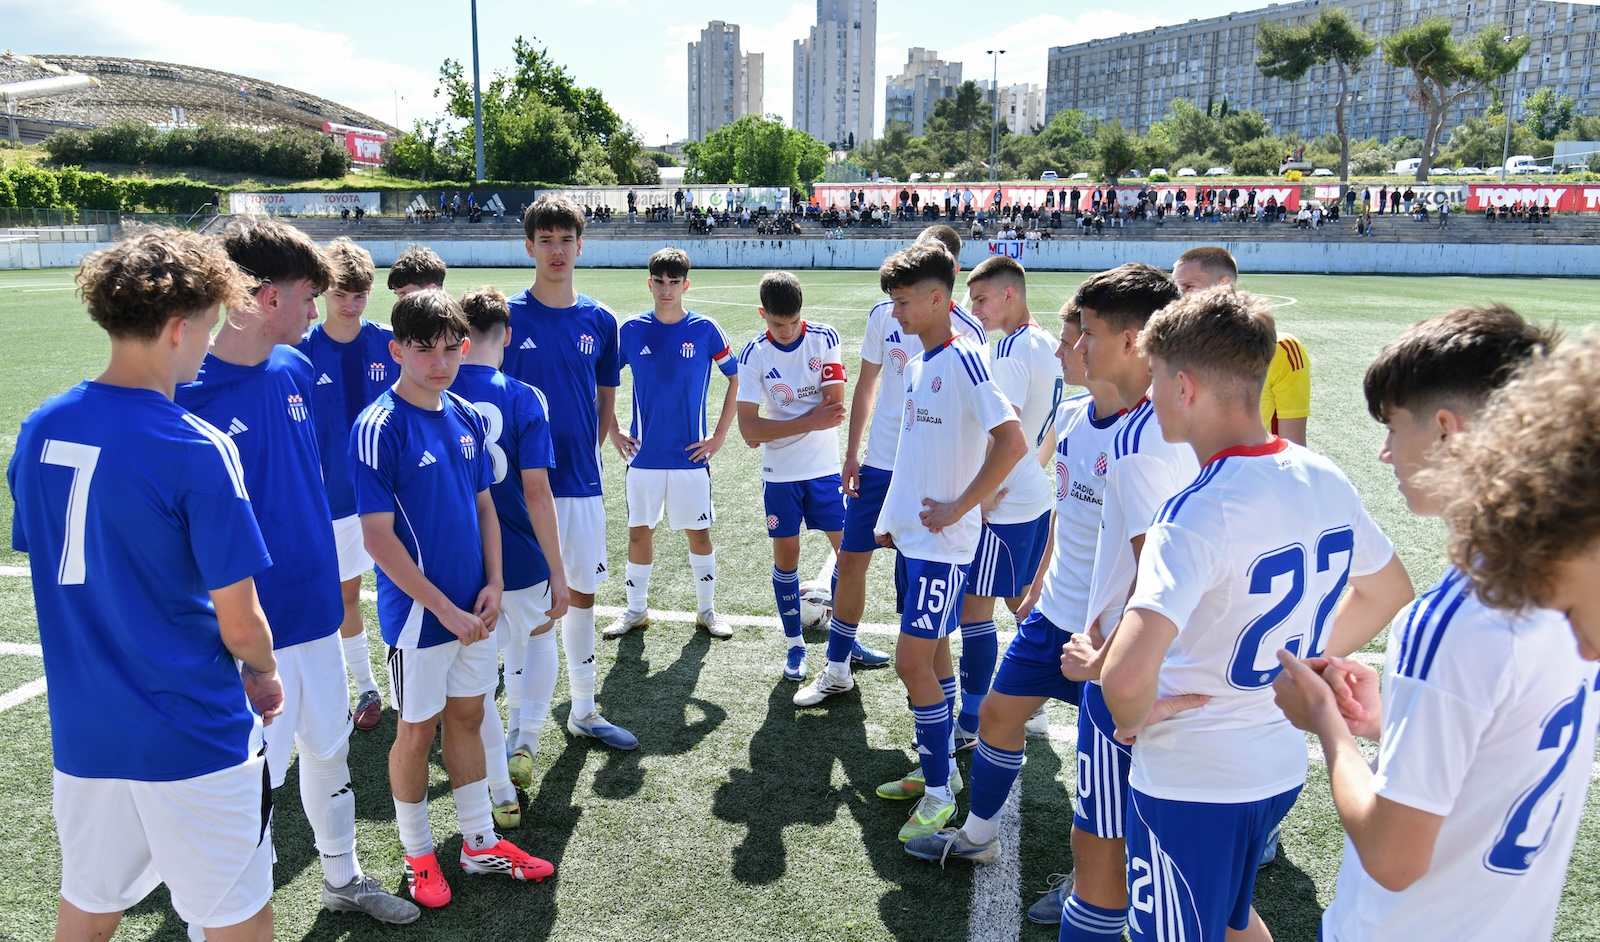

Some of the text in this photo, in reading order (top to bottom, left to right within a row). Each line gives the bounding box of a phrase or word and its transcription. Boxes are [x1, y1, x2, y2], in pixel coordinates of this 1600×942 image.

[249, 195, 286, 204] TOYOTA
[324, 194, 360, 204] TOYOTA
[1476, 188, 1567, 208] TOMMY
[823, 366, 834, 379] C
[1070, 489, 1104, 507] DALMAC
[1073, 480, 1095, 497] RADIO
[40, 438, 102, 585] 7
[918, 576, 946, 614] 15
[1225, 524, 1355, 691] 22
[1483, 667, 1600, 876] 2
[1125, 845, 1154, 914] 2
